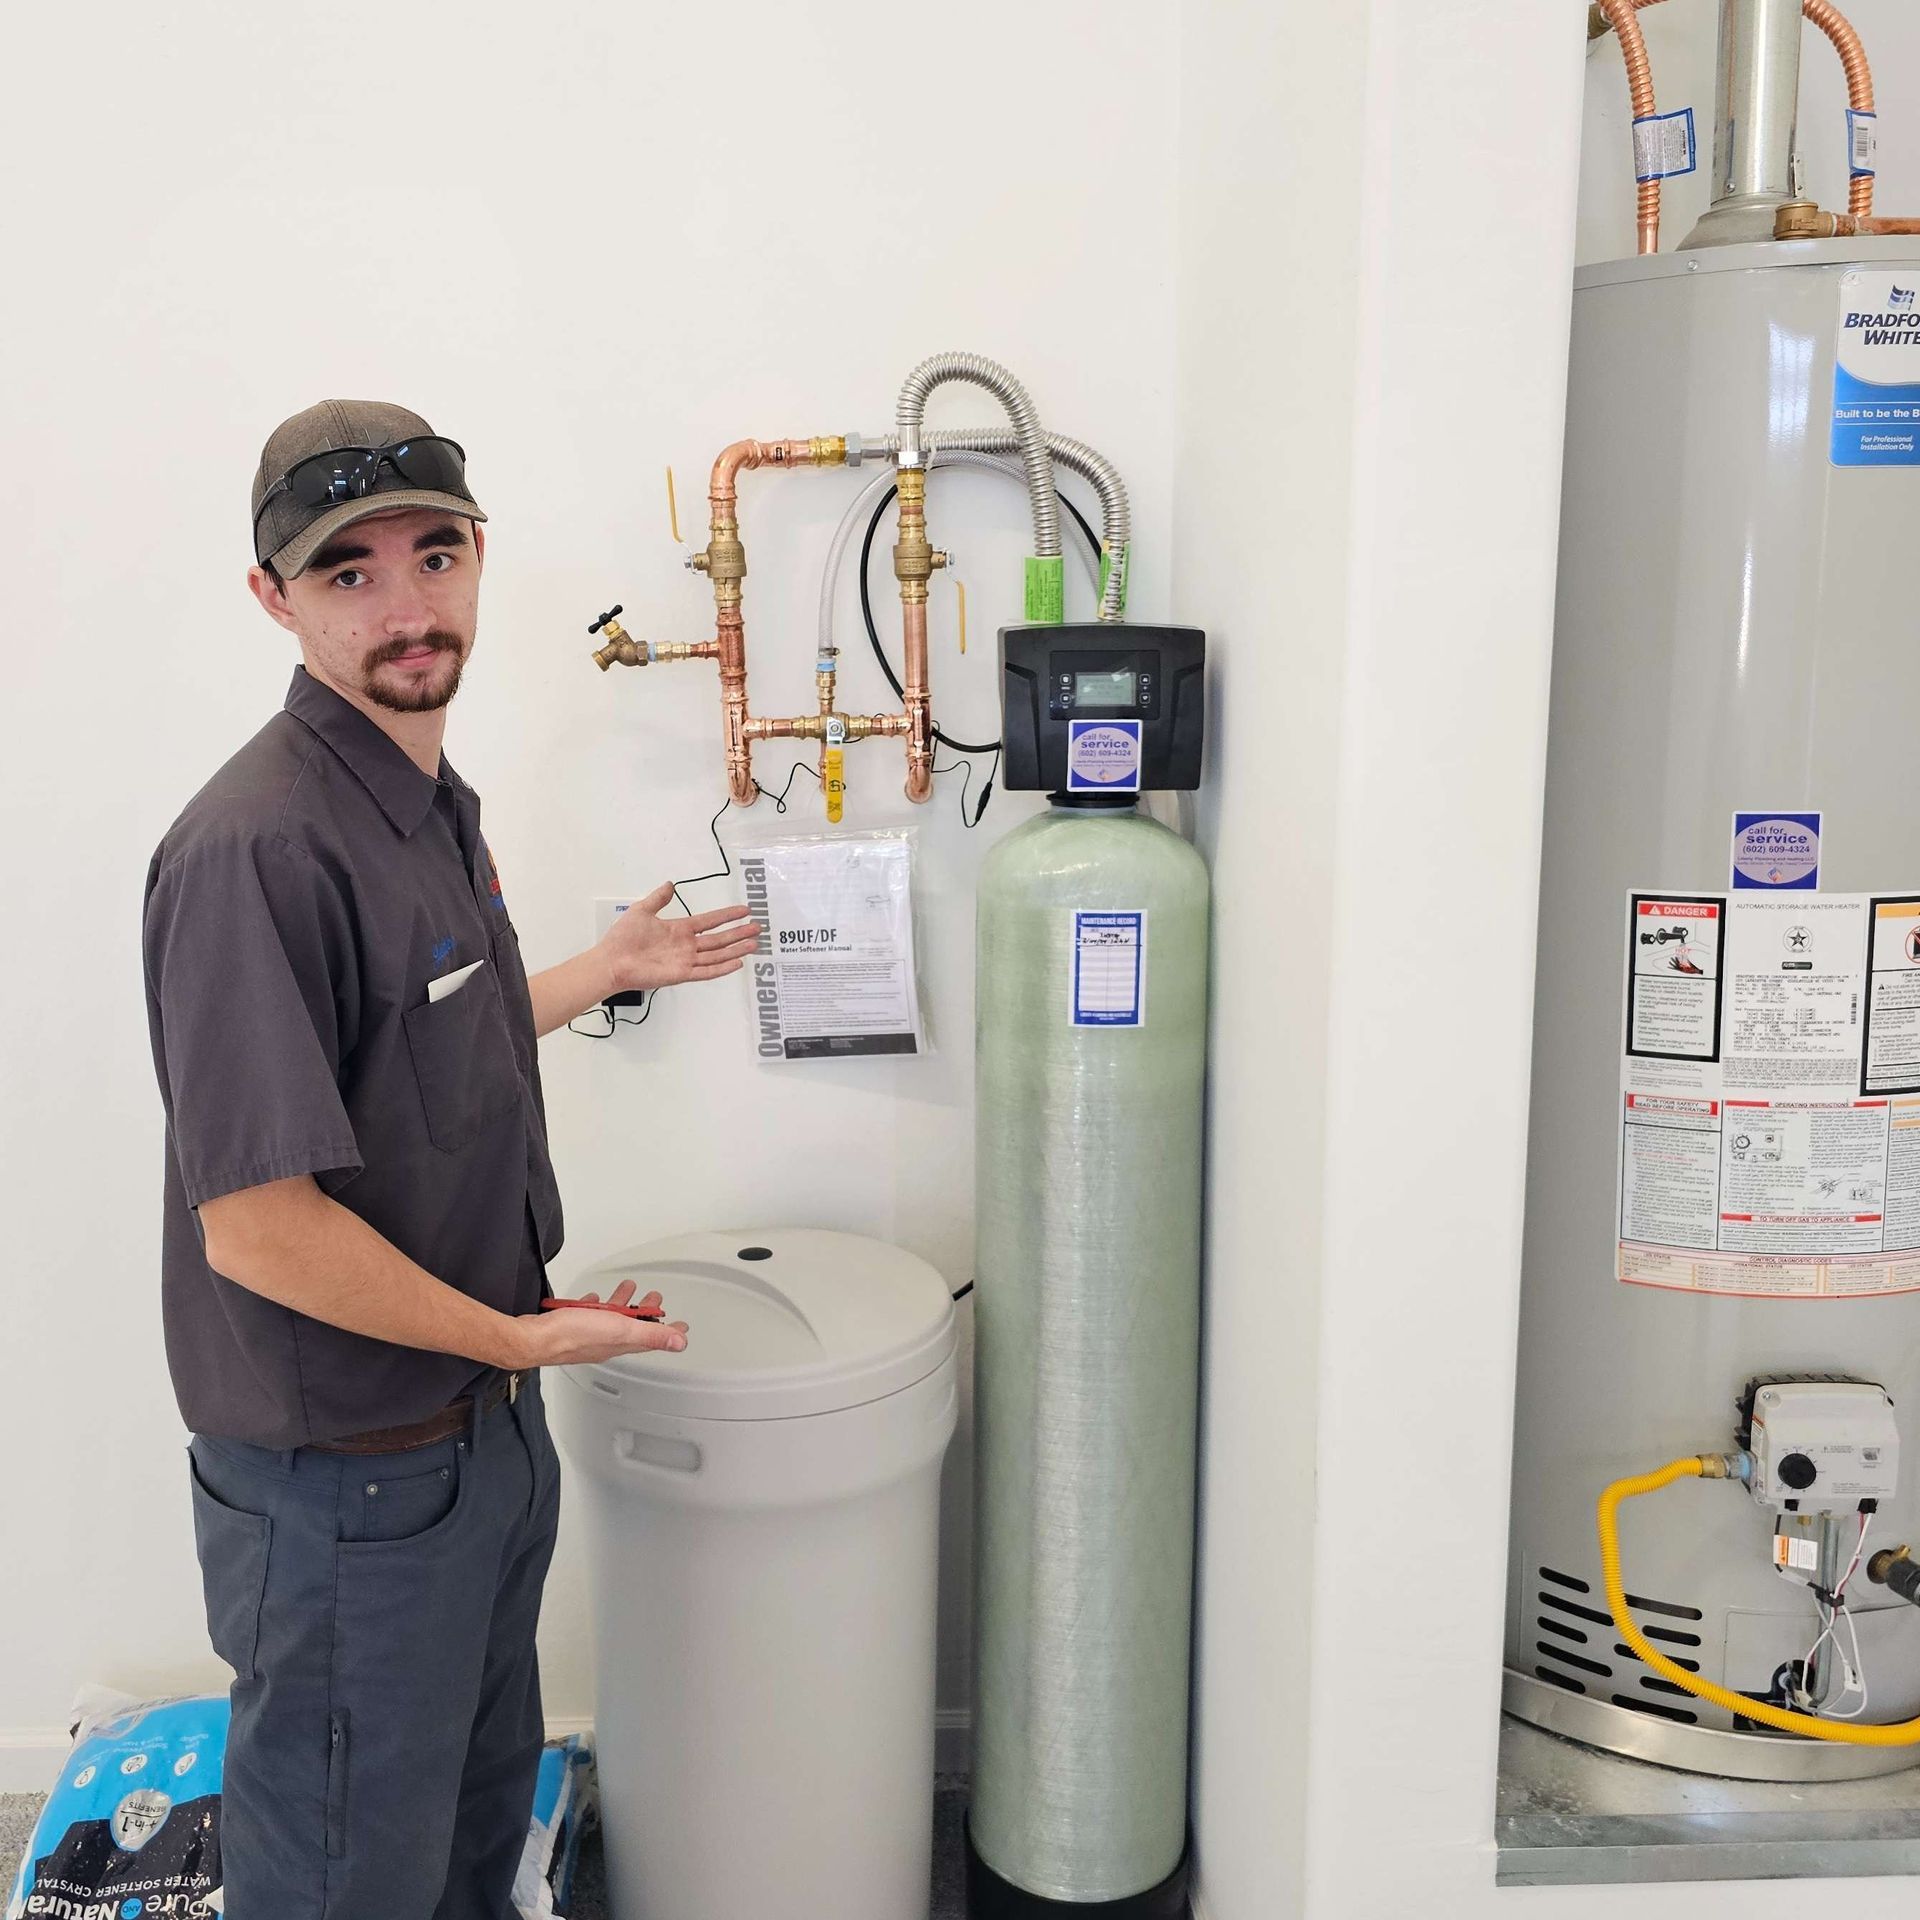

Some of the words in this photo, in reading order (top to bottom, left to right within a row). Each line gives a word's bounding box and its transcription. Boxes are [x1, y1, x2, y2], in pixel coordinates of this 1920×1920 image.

[1844, 313, 1920, 328] BRADFO
[1864, 330, 1920, 345] WHITE
[1835, 410, 1860, 418] Built
[1863, 410, 1874, 418] to
[1876, 409, 1890, 418] be
[1894, 409, 1910, 418] the
[1899, 444, 1914, 452] Only
[1081, 740, 1129, 748] service
[1748, 826, 1766, 834] call
[1770, 826, 1784, 834] for
[1746, 834, 1808, 844] service
[1742, 845, 1766, 854] (602)
[1768, 845, 1810, 854] 609-4324
[1664, 906, 1708, 916] DANGER
[779, 929, 838, 944] 89UF/DF
[828, 944, 852, 952] Manual
[754, 961, 784, 1058] Owners
[165, 1876, 211, 1888] WATER
[96, 1879, 162, 1898] SOFTENER
[122, 1904, 141, 1913] AND
[145, 1893, 211, 1917] Pure
